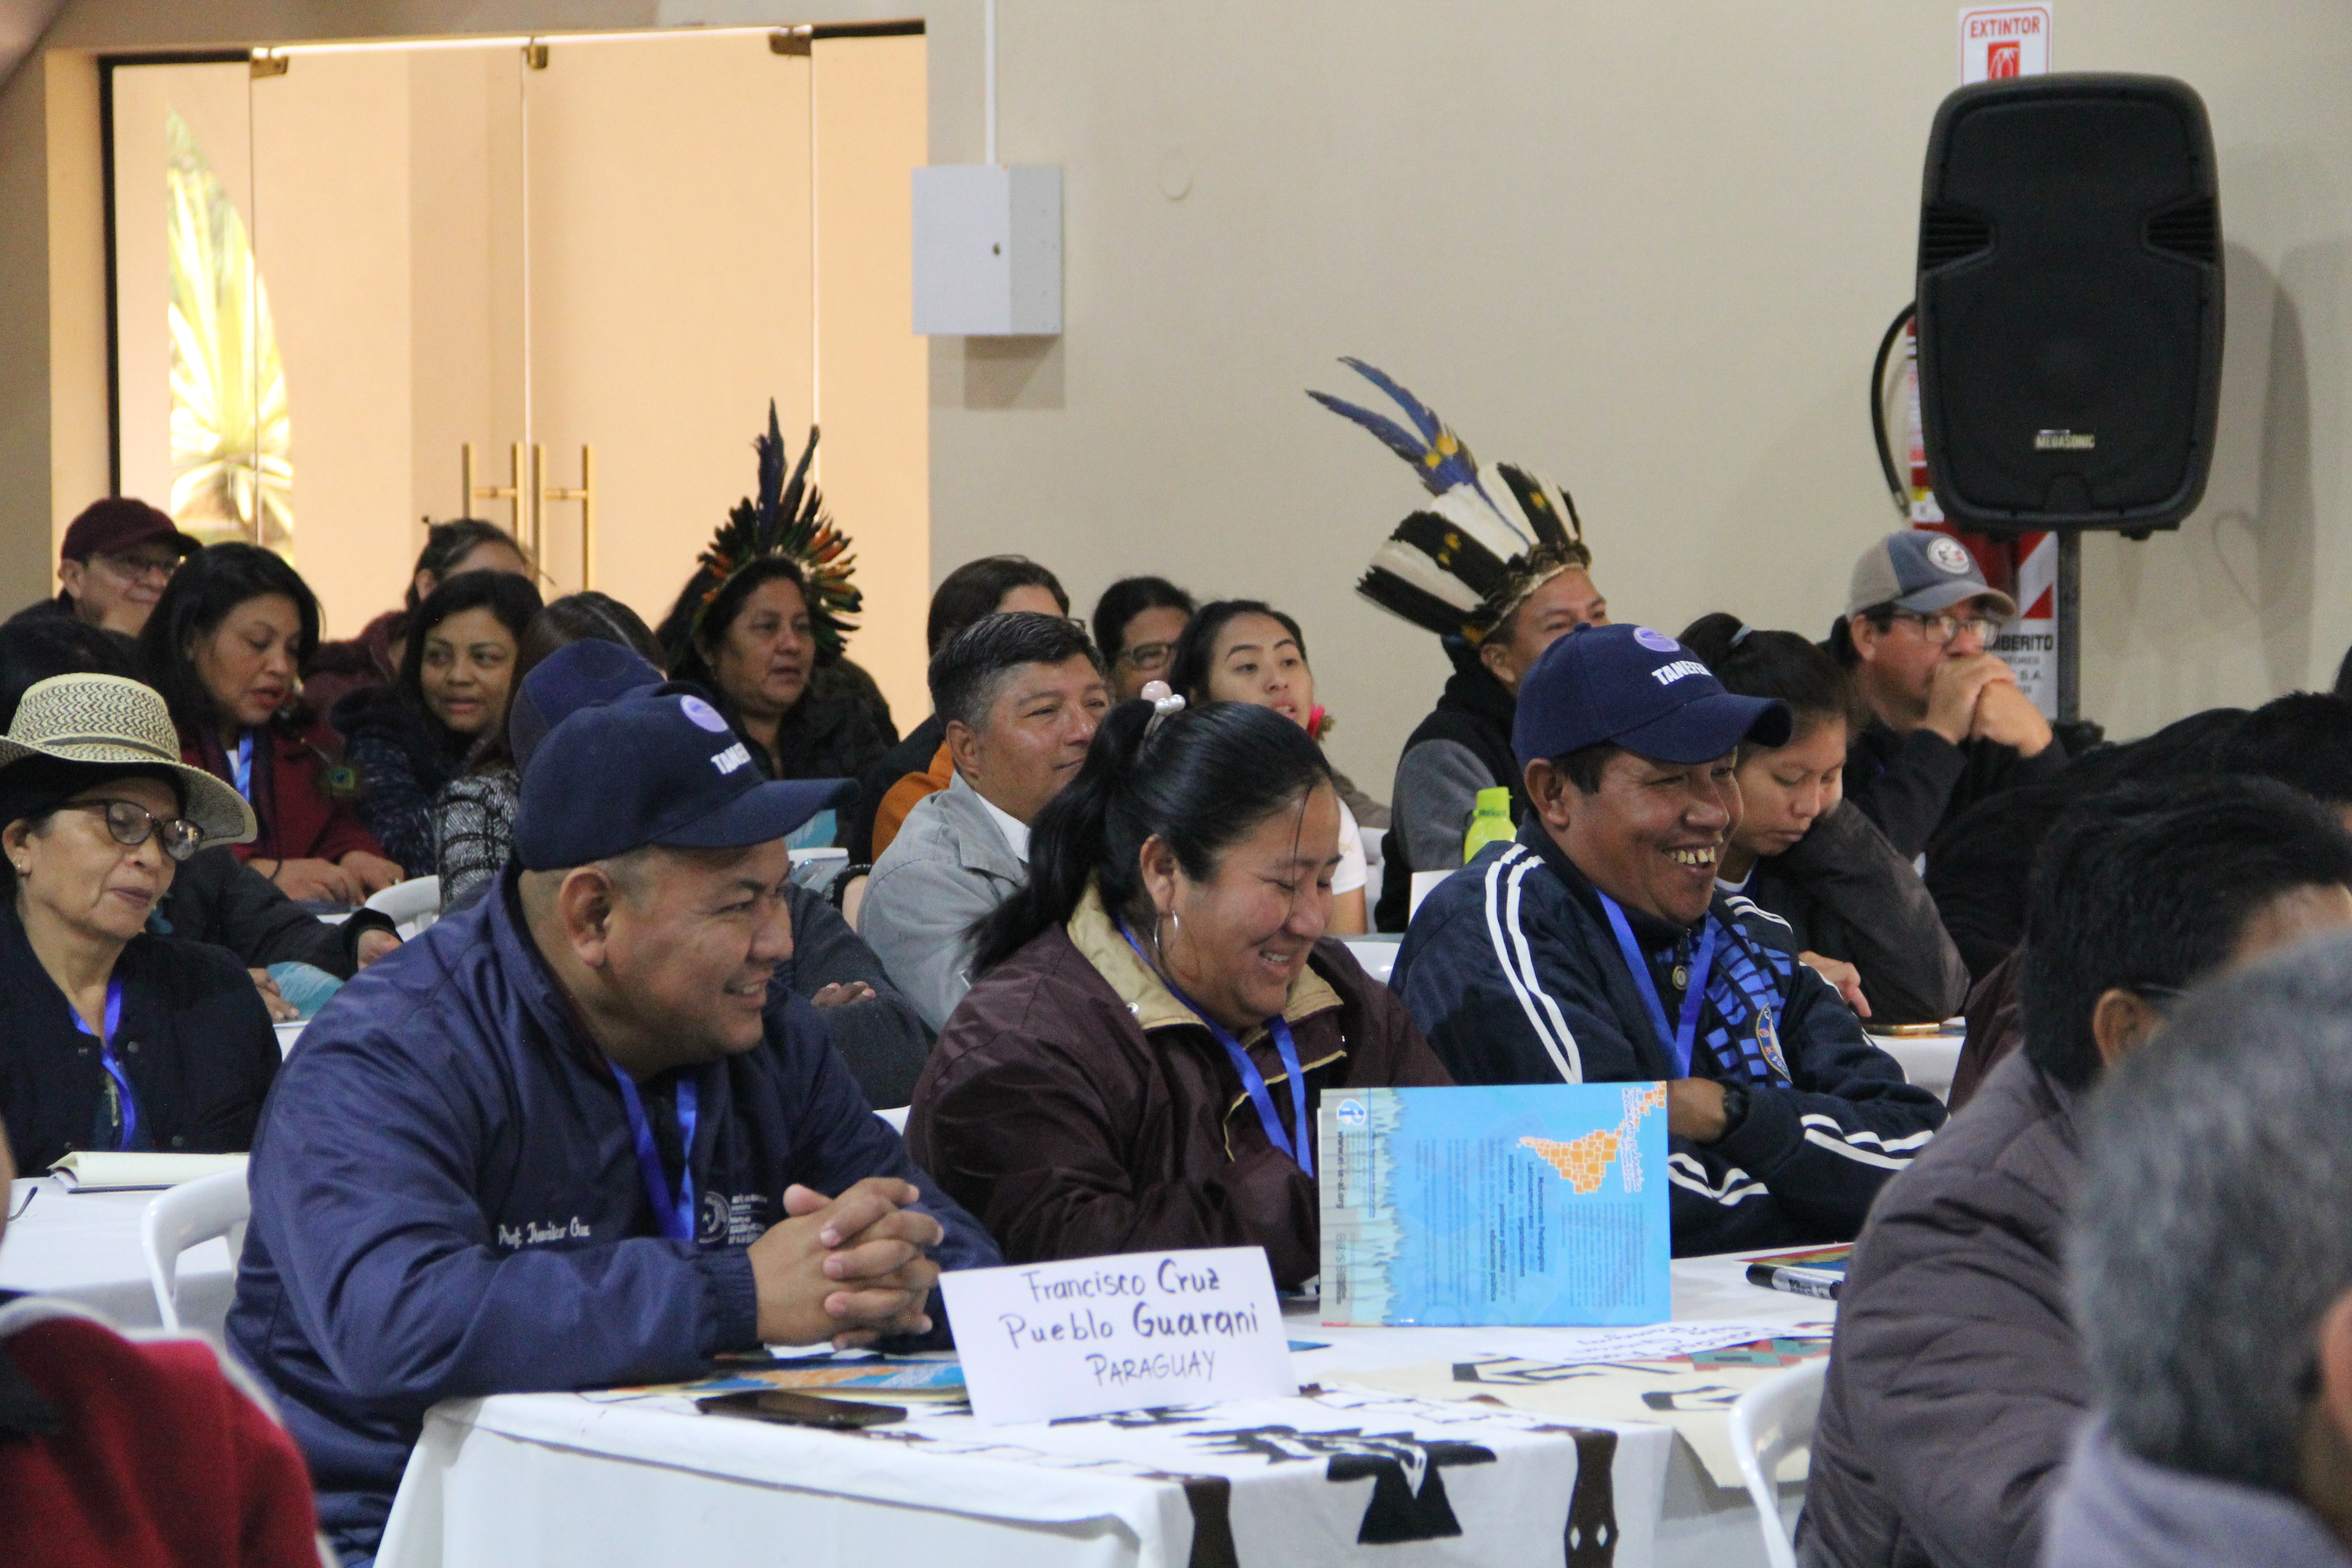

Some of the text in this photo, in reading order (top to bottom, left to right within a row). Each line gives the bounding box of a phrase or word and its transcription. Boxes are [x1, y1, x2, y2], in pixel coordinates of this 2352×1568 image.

[1970, 15, 2040, 38] EXTINTOR
[1499, 1240, 1507, 1272] públicas
[1021, 1258, 1220, 1302] Francisco Cruz
[999, 1301, 1259, 1349] Pueblo Guarani
[1085, 1350, 1216, 1387] PARAGUAY
